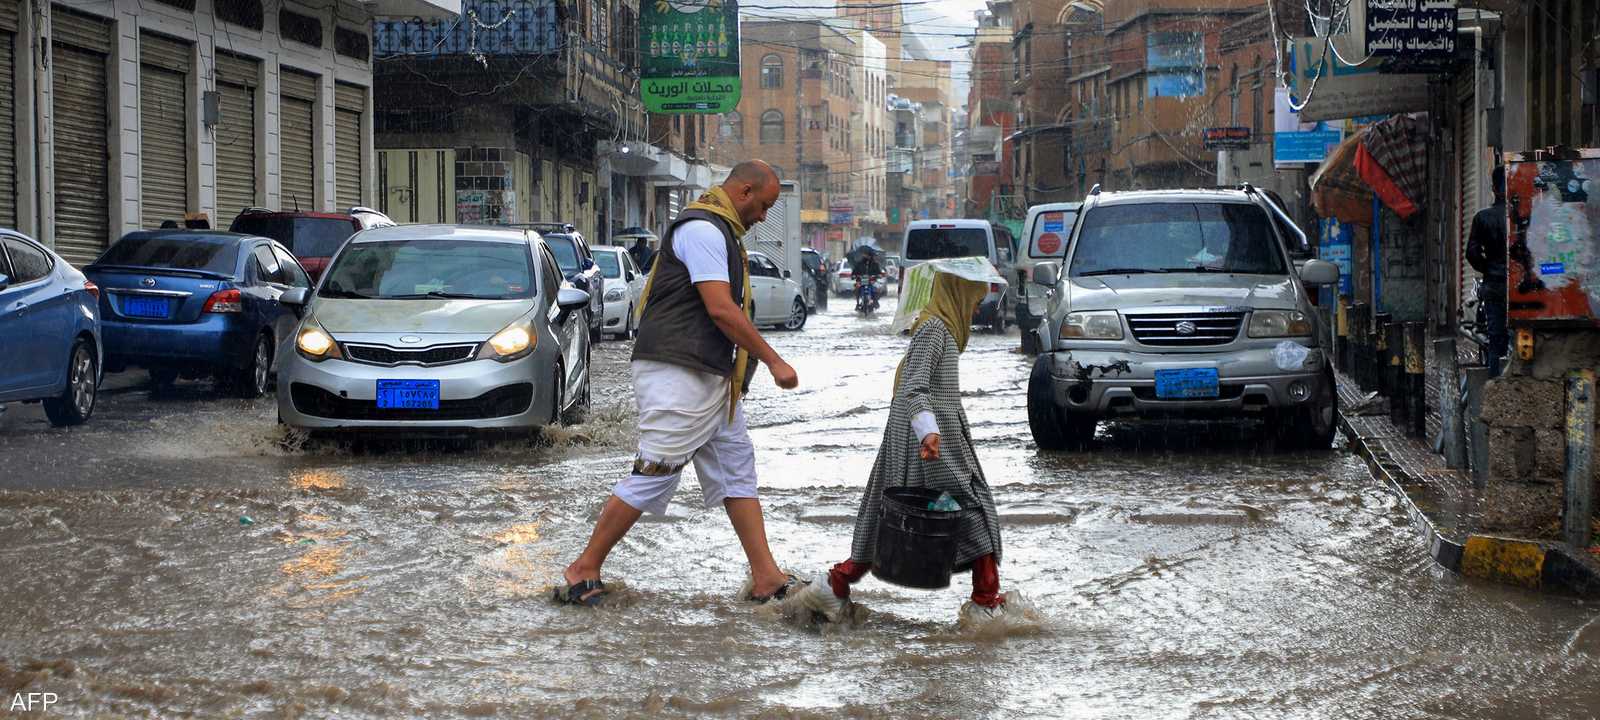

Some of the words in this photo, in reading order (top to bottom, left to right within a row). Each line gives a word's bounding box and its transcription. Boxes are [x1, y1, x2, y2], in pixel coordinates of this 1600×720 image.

[1368, 16, 1414, 32] التجميل
[1417, 12, 1454, 32] وأدوات
[648, 80, 688, 98] الوريث
[692, 81, 734, 94] محلات
